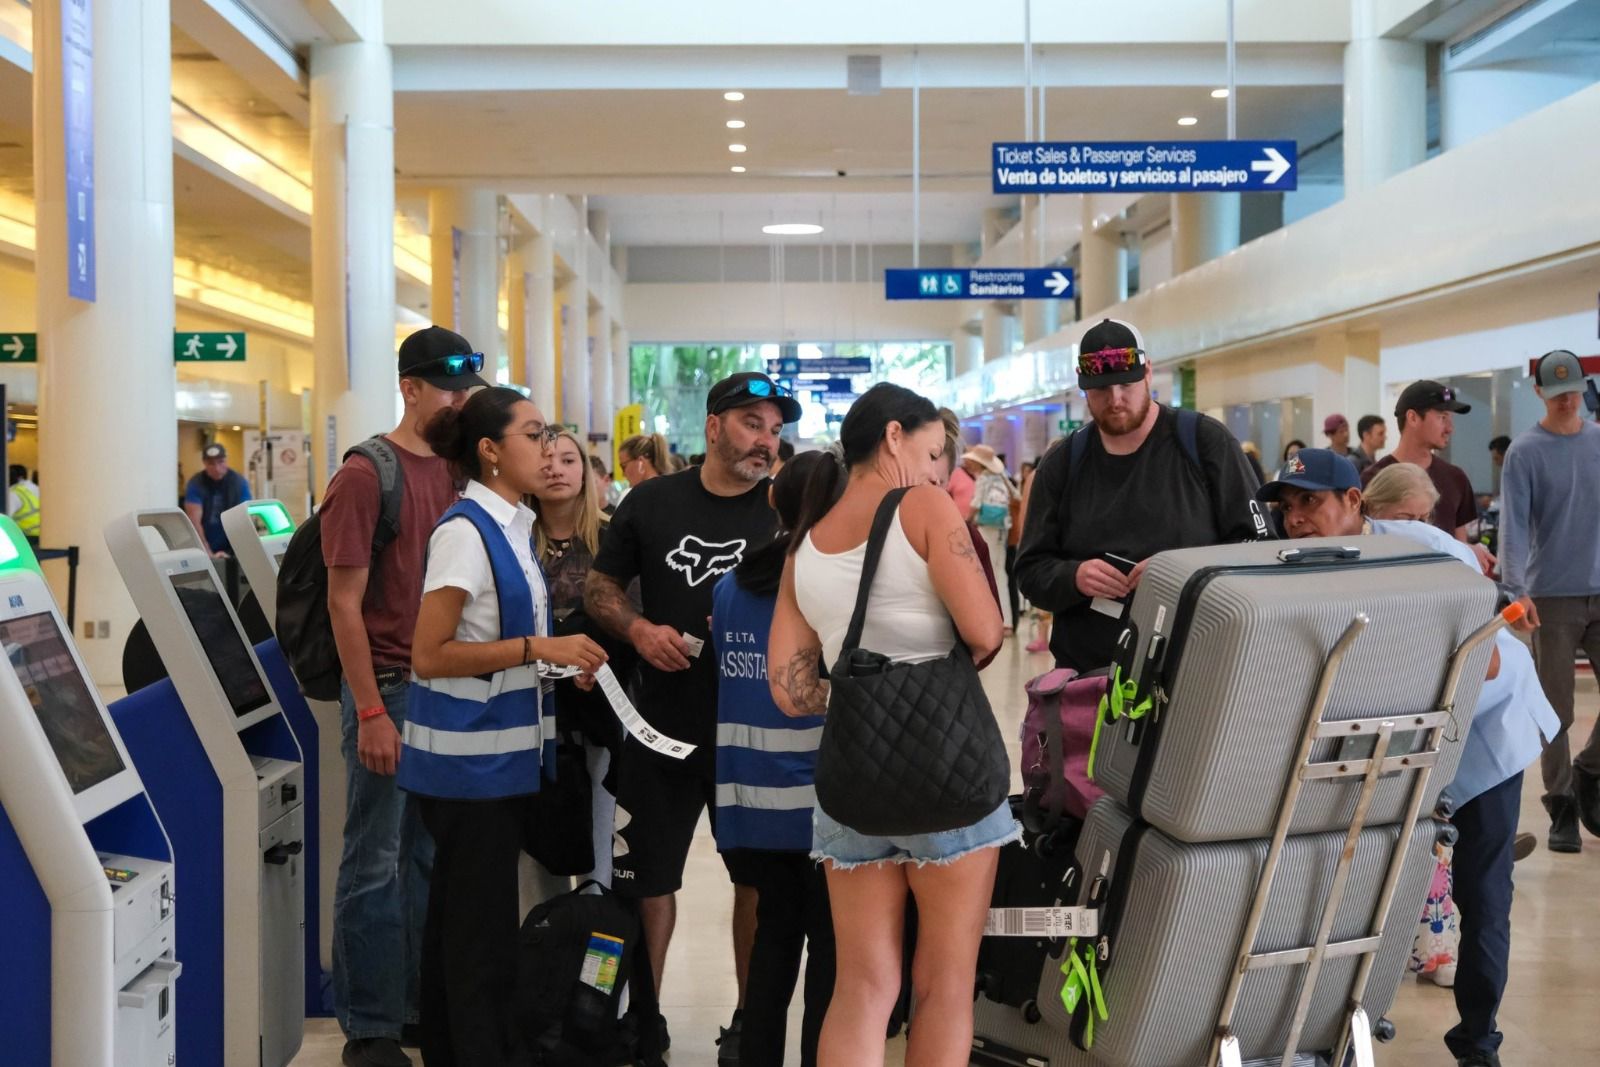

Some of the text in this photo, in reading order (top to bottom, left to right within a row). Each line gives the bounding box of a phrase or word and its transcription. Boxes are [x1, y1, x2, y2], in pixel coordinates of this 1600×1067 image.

[997, 145, 1197, 167] Ticket Sales & Passenger Services
[997, 166, 1248, 188] Venta de boletos y servicios al pasajero
[969, 270, 1026, 283] Restrooms
[969, 283, 1026, 296] Sanitarios
[1249, 499, 1268, 537] car
[720, 650, 768, 681] ASSISTA
